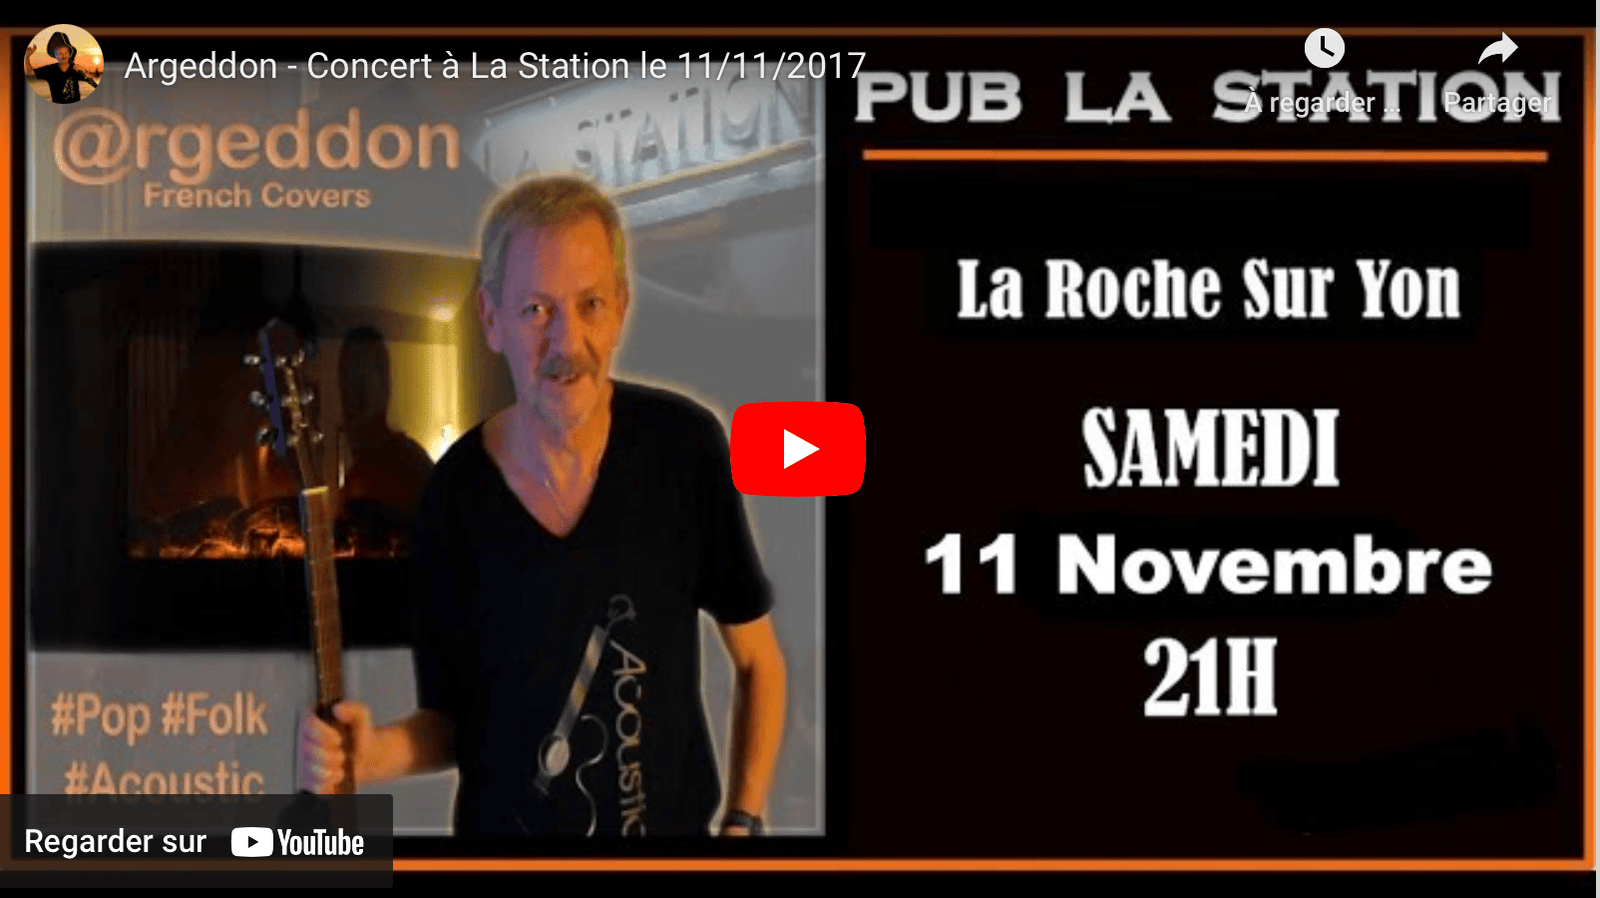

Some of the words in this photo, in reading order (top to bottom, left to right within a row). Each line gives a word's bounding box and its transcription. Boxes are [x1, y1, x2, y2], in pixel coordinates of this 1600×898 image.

[853, 71, 1022, 124] PUB
[1065, 71, 1173, 125] LA
[1212, 69, 1562, 124] STATION
[53, 106, 461, 187] @rgeddon
[143, 181, 254, 210] French
[261, 182, 372, 210] Covers
[957, 258, 1024, 320] La
[1045, 258, 1222, 320] Roche
[1242, 256, 1335, 320] Sur
[1355, 258, 1461, 320] Yon
[1082, 406, 1340, 488] SAMEDI
[925, 533, 1016, 595] 11
[1058, 533, 1494, 595] Novembre
[1143, 636, 1279, 718] 21H
[50, 690, 152, 747] #Pop
[161, 690, 269, 736] #Folk
[63, 760, 266, 804] #Acoustic
